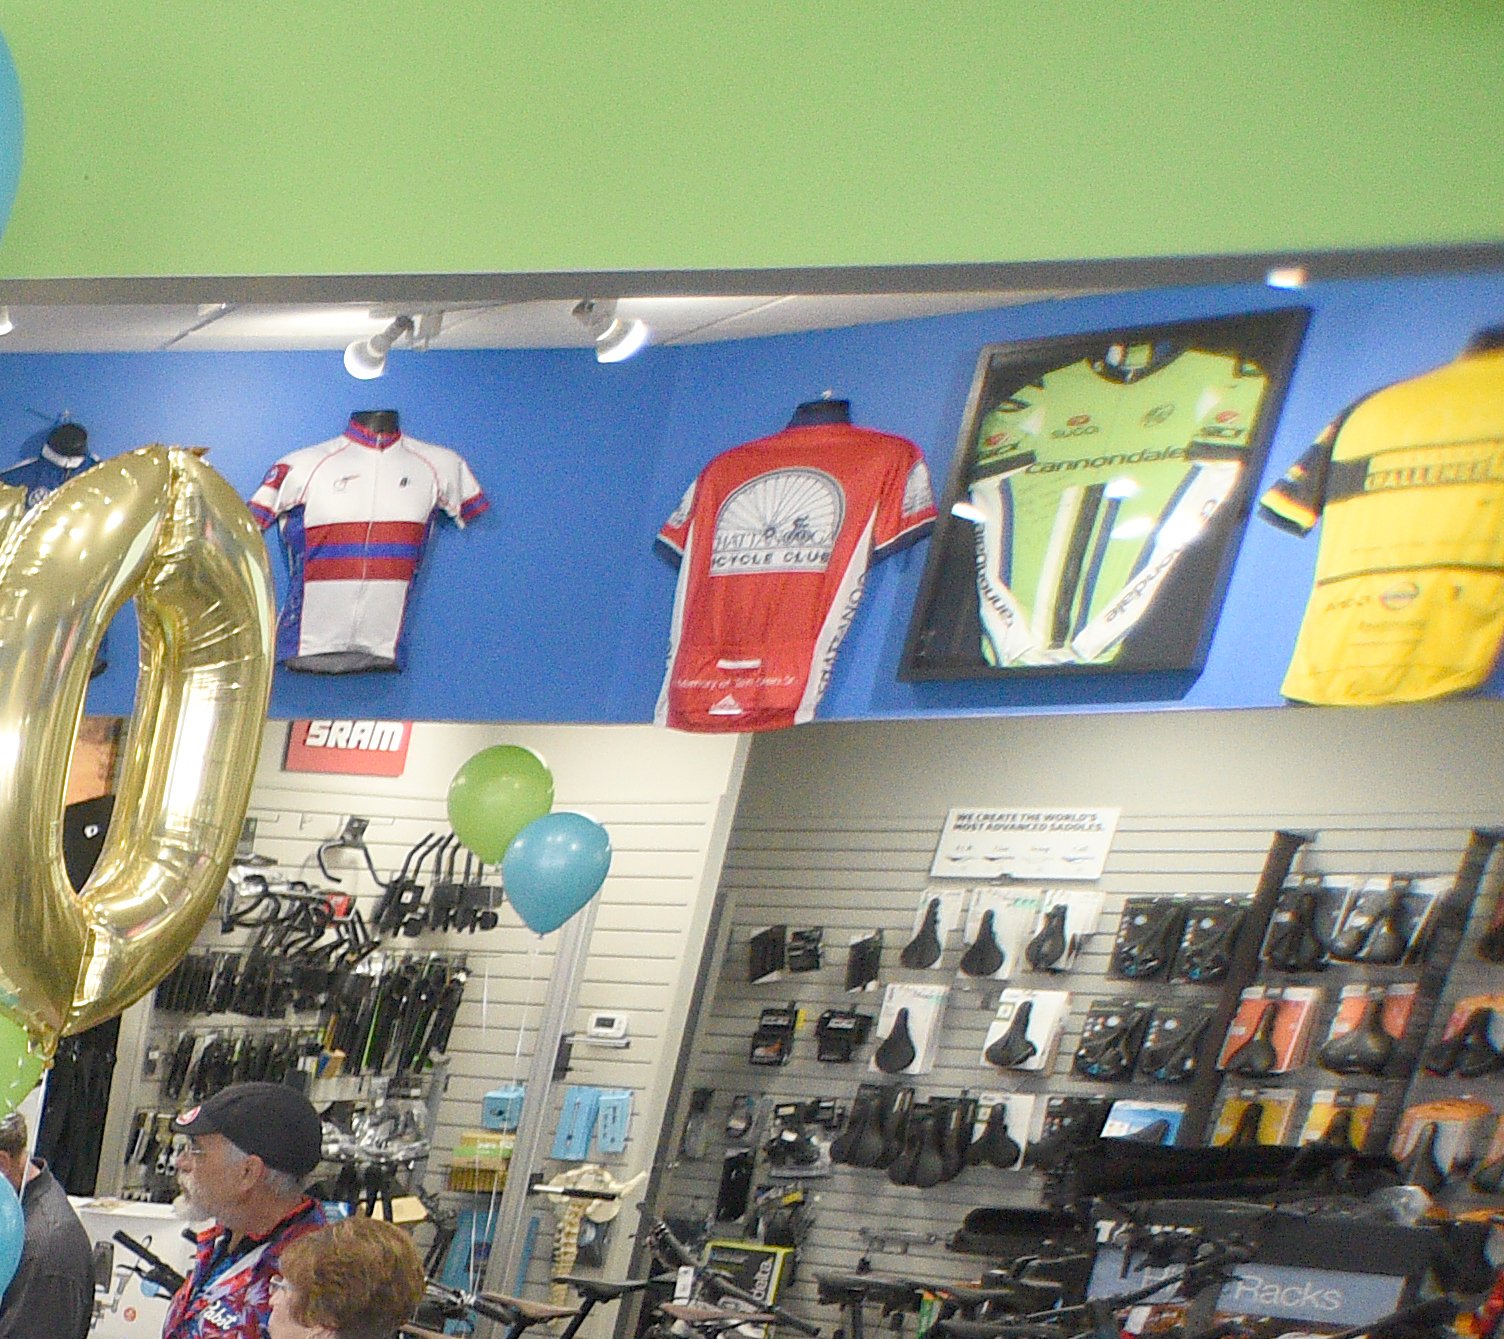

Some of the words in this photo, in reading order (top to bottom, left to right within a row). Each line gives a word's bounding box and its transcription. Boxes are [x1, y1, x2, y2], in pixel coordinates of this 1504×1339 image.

[1025, 445, 1187, 474] cannondale
[305, 720, 403, 752] SRAM
[953, 823, 983, 831] MOST
[987, 823, 1048, 831] ADVANCED
[975, 813, 1017, 821] CREATE
[1020, 813, 1040, 821] THE
[1044, 812, 1098, 821] WORLD'S
[1236, 1274, 1342, 1311] Racks
[204, 1300, 238, 1331] Pabst
